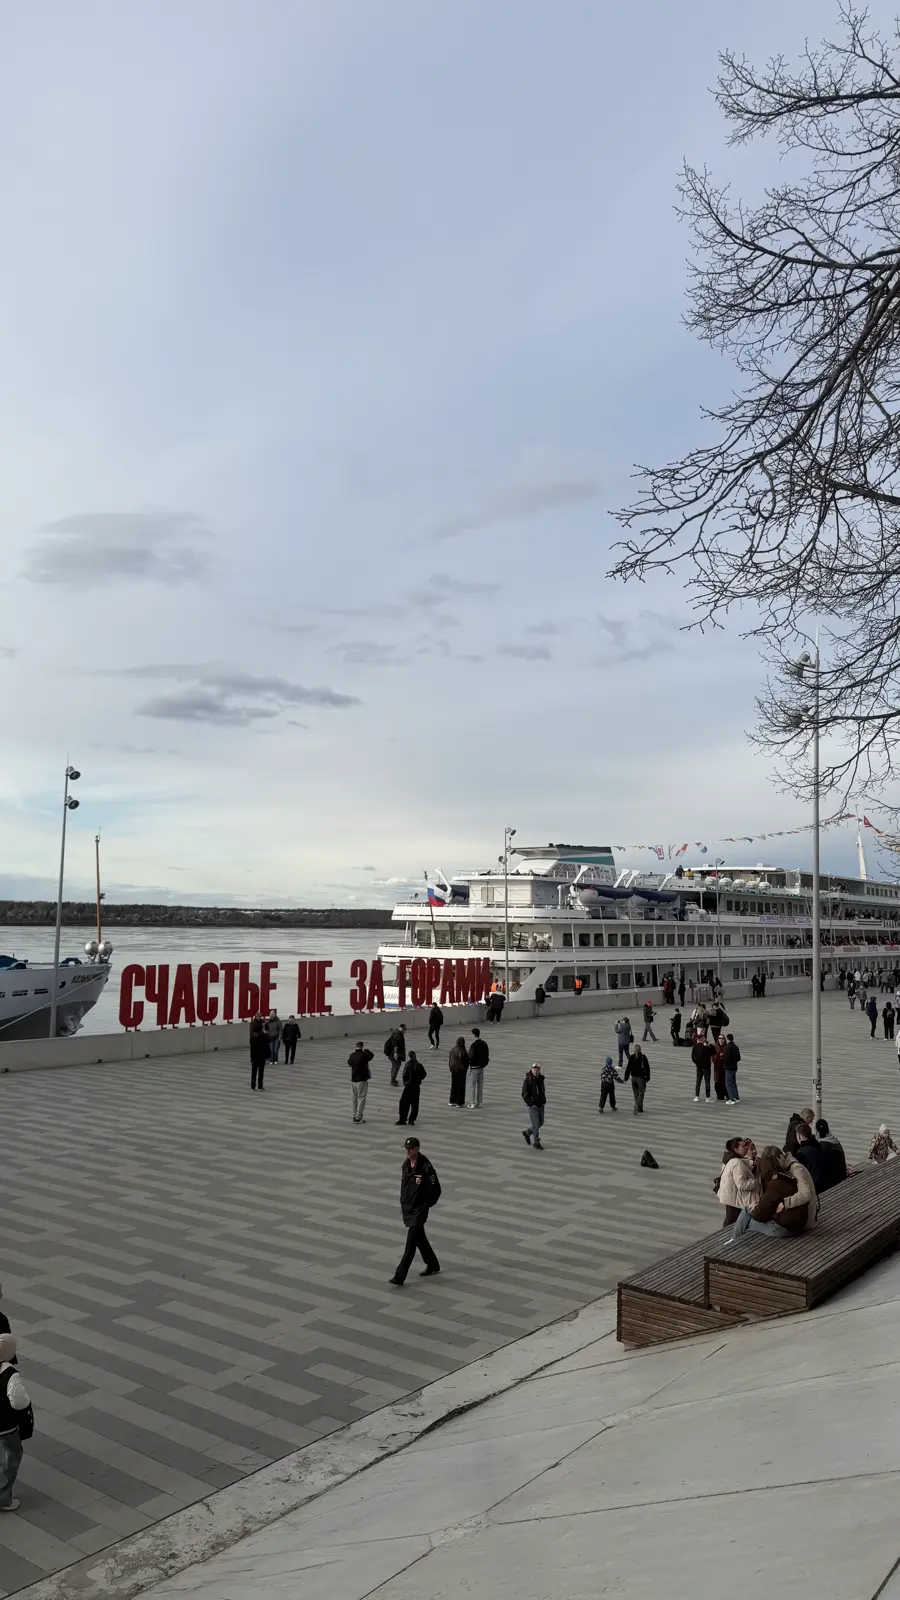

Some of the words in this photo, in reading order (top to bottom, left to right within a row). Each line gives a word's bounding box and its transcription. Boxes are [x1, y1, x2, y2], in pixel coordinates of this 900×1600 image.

[119, 961, 278, 1027] СЧАСТЬЕ
[297, 960, 333, 1014] НЕ
[350, 959, 385, 1011] ЗА
[399, 957, 491, 1008] ГОРАМИ
